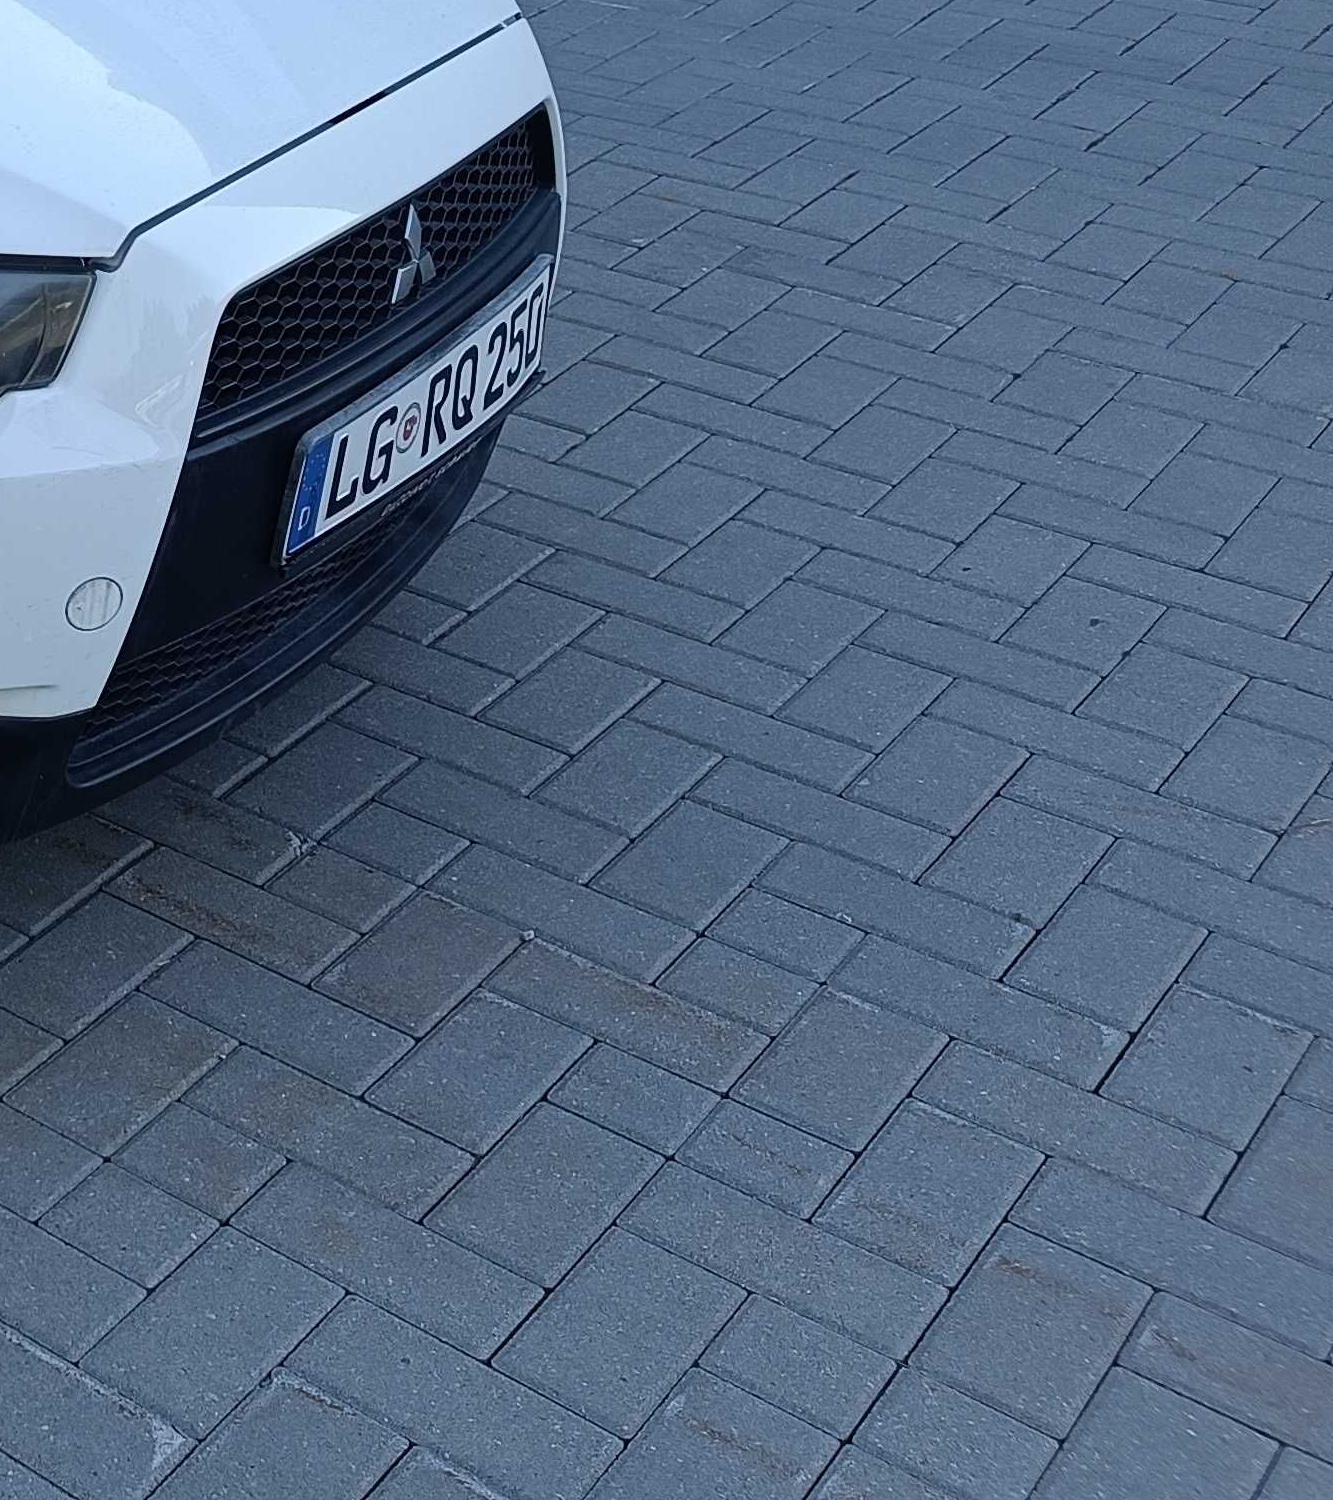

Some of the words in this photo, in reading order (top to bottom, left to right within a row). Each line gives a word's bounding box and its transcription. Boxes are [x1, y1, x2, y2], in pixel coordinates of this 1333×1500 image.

[325, 404, 399, 520] LG
[420, 343, 479, 458] RQ
[483, 282, 545, 411] 250
[297, 506, 311, 532] D
